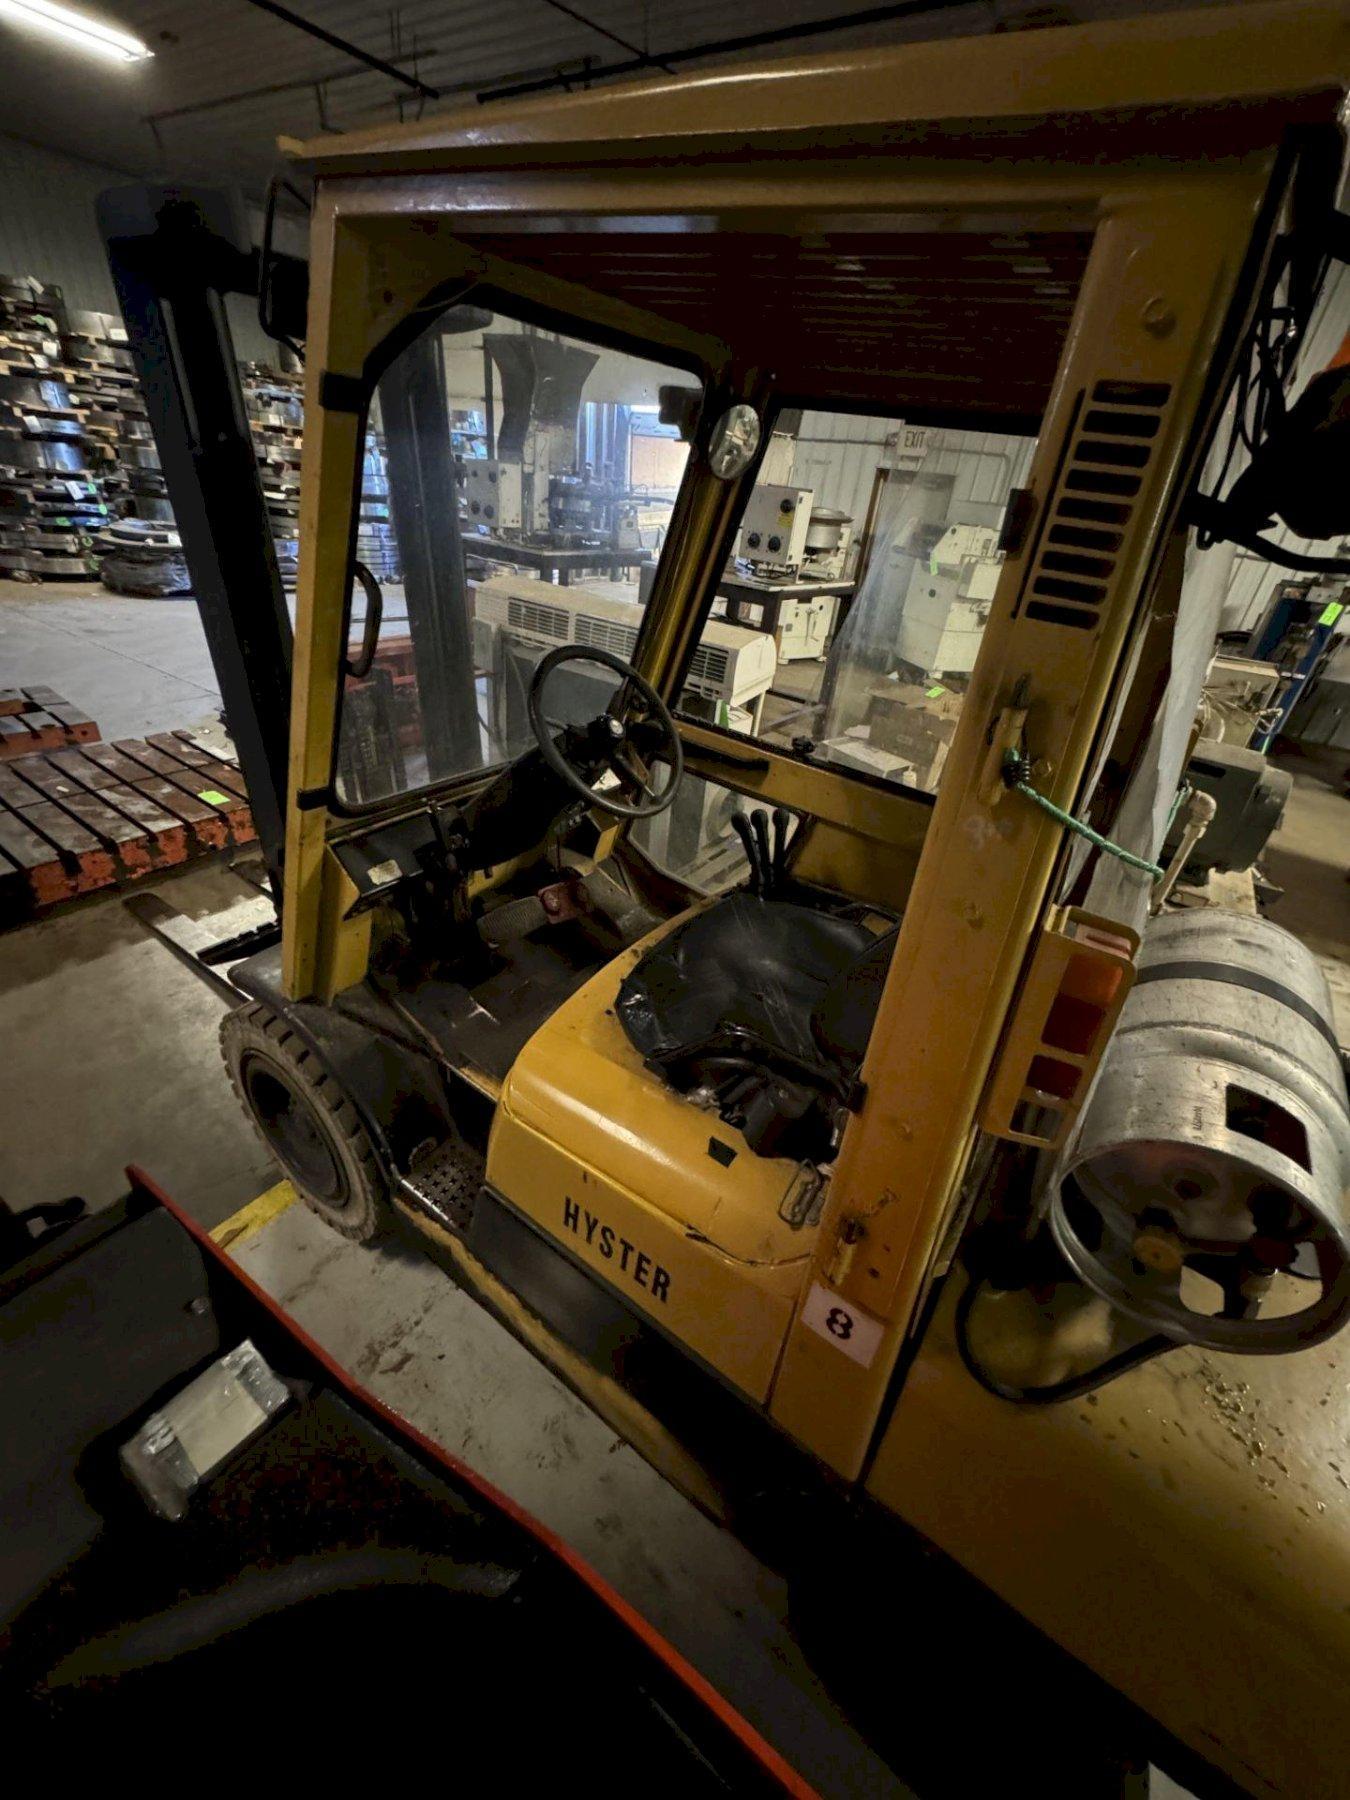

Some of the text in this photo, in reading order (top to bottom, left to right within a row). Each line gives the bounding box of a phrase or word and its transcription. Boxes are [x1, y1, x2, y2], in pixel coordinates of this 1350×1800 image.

[904, 430, 926, 448] EXIT
[563, 1196, 671, 1303] HYSTER
[825, 1307, 854, 1340] 8
